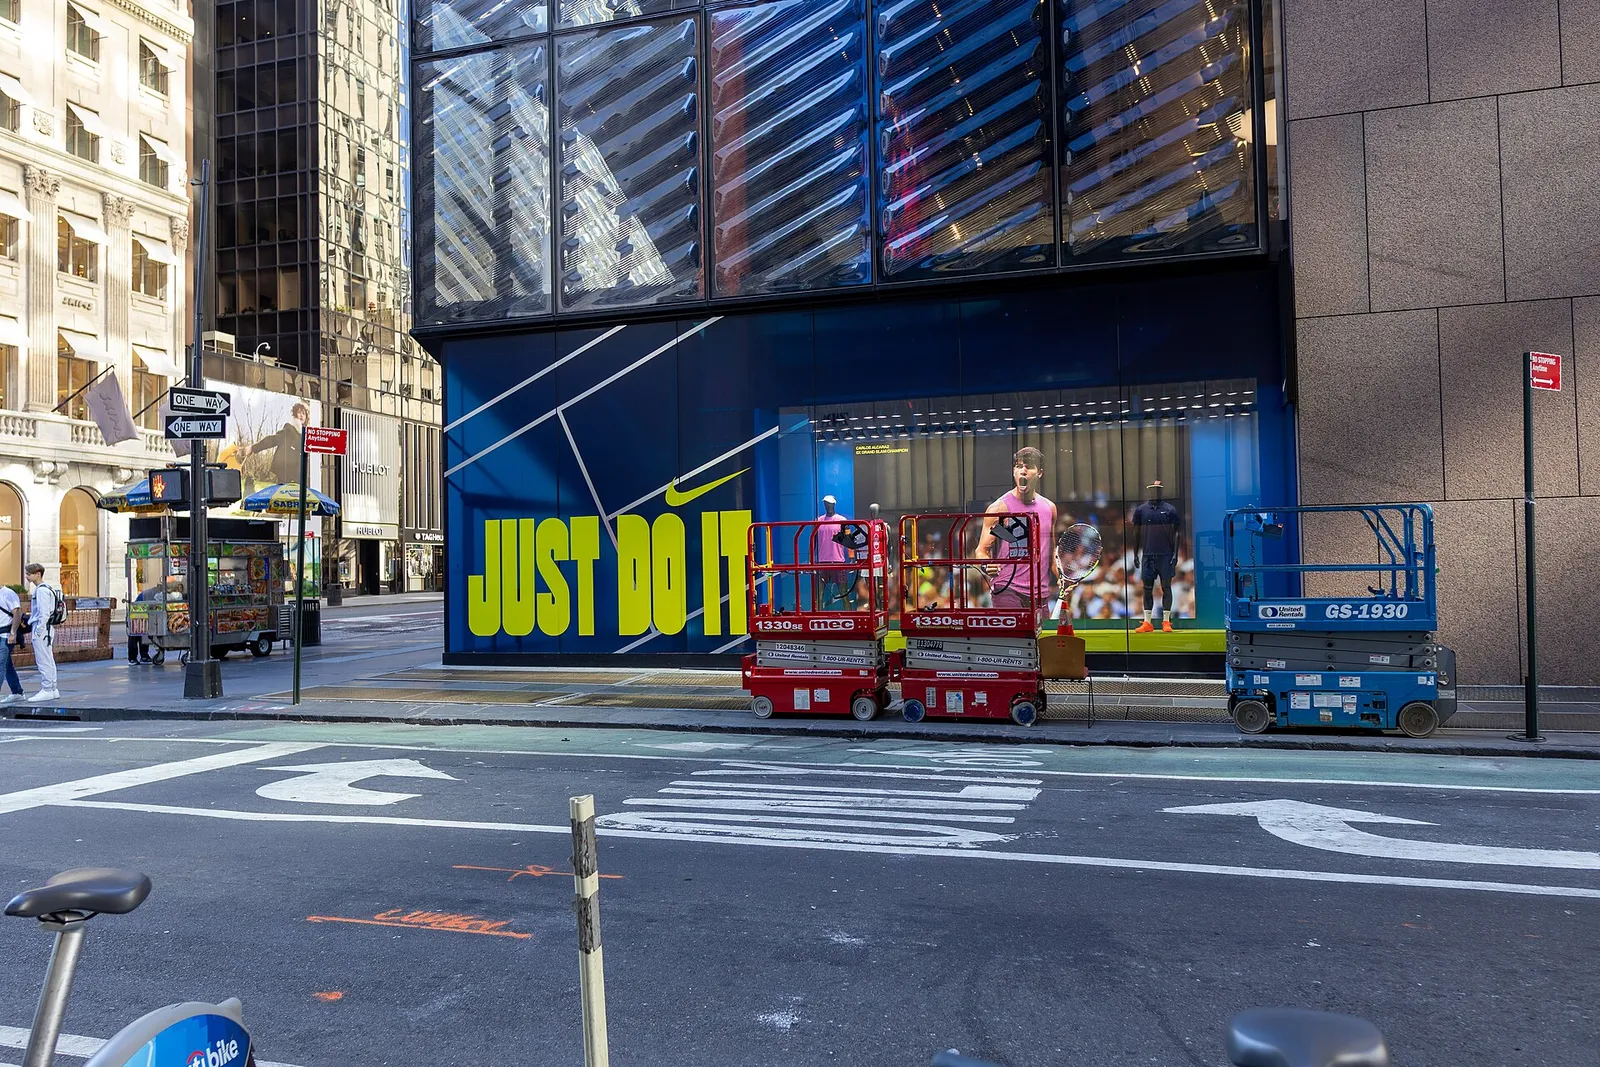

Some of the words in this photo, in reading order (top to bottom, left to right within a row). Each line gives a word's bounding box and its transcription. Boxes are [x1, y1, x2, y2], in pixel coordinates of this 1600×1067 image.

[175, 394, 196, 406] ONE
[204, 397, 224, 409] WAY
[173, 422, 192, 432] ONE
[199, 421, 218, 432] WAY
[316, 430, 341, 438] STOPPING
[352, 461, 391, 476] HUBLOT
[273, 500, 319, 509] SABRTT
[356, 526, 384, 536] HUBLOT
[468, 517, 599, 637] JUST
[617, 512, 686, 636] DO
[701, 509, 752, 636] IT
[1325, 603, 1409, 619] GS-1930
[755, 620, 803, 631] 1330SE
[809, 619, 855, 630] mec
[912, 615, 964, 627] 1330SE
[966, 616, 1017, 628] mec
[205, 1039, 239, 1067] bike
